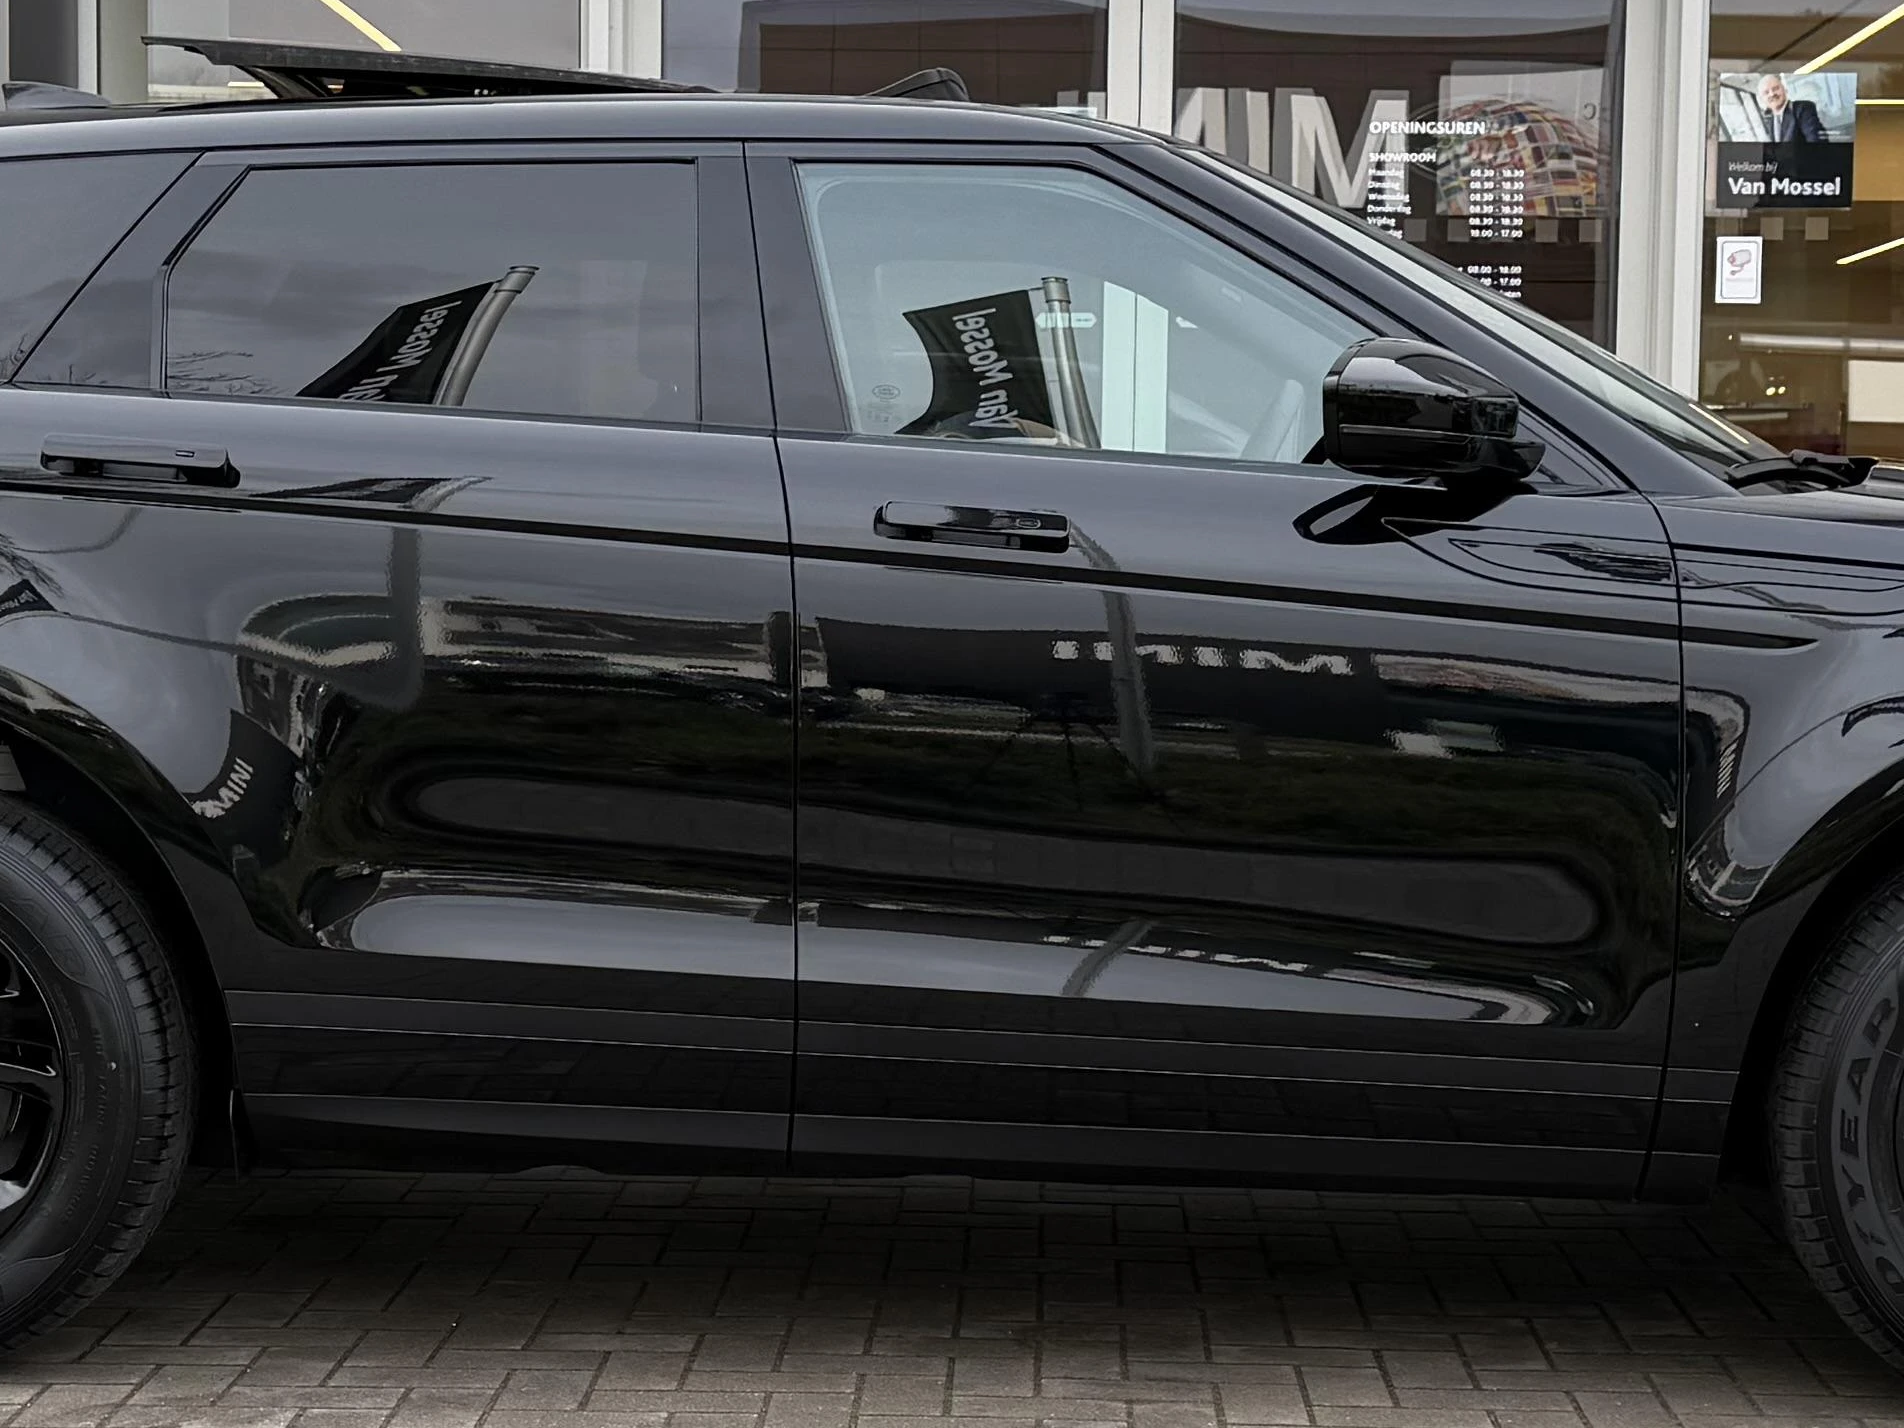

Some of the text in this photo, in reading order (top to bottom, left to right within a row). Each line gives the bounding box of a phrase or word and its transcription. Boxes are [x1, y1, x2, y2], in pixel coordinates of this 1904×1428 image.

[1369, 121, 1486, 135] OPENINGSUREN
[1368, 152, 1437, 163] SHOWROOM
[1728, 161, 1778, 175] Welkom bij
[1728, 176, 1841, 196] Van Mossel
